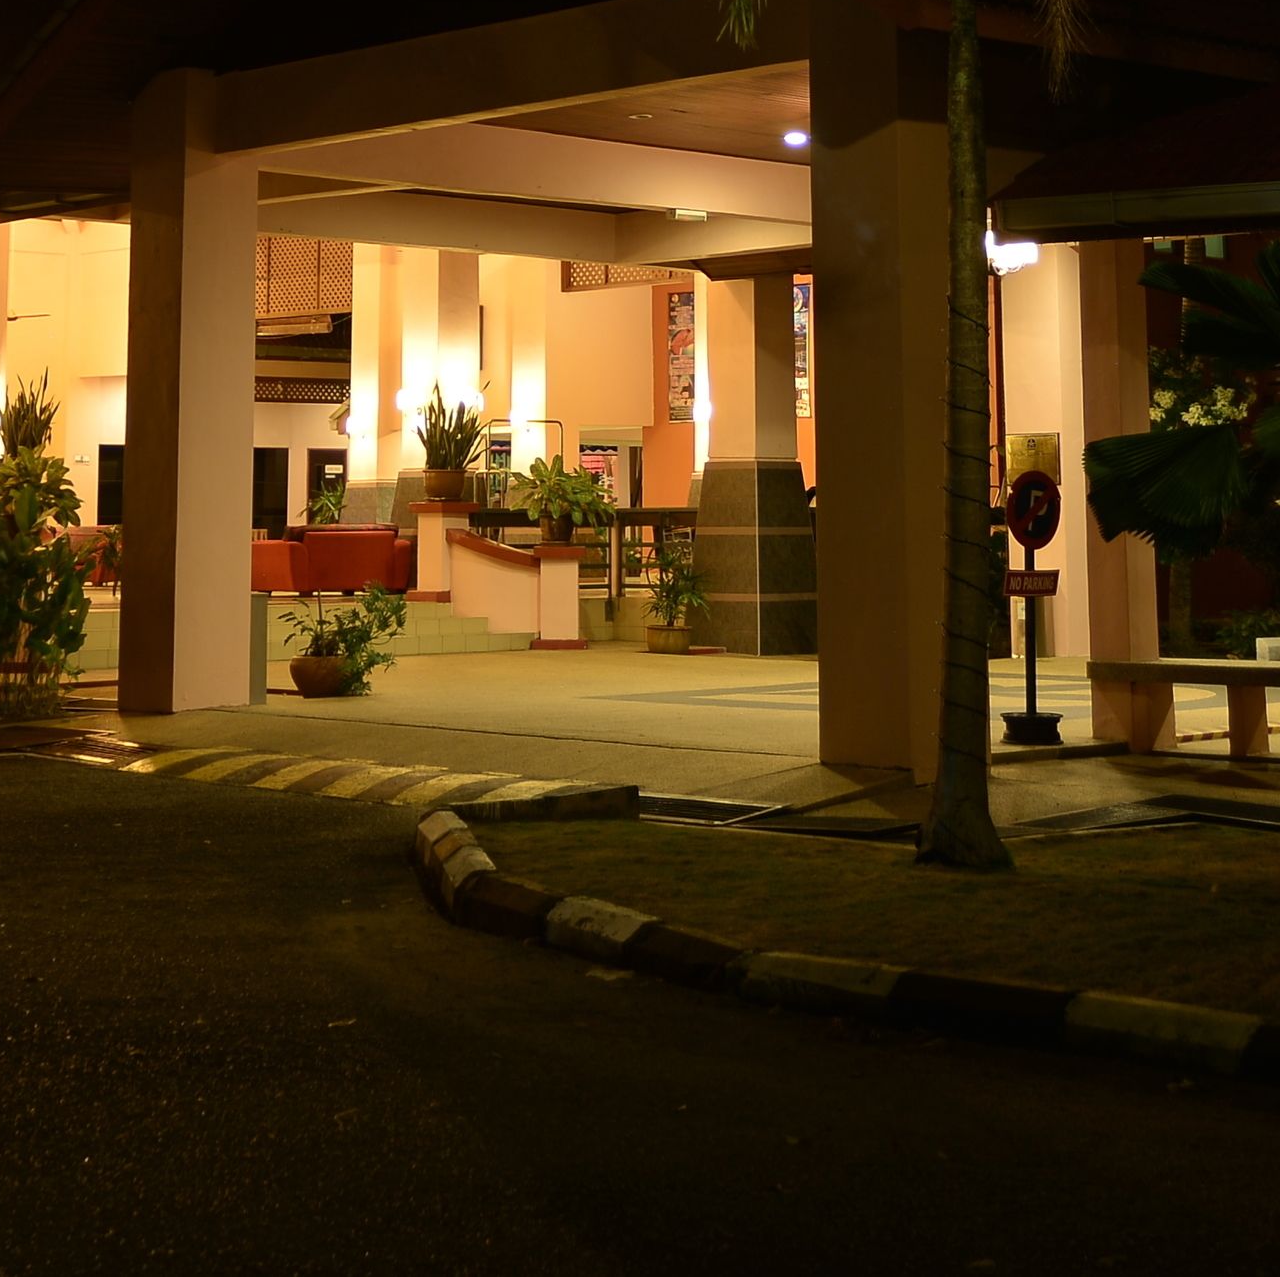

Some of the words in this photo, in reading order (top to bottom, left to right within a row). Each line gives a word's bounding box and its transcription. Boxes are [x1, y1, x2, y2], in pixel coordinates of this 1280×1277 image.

[1027, 489, 1048, 531] P
[1009, 576, 1022, 591] NO
[1023, 575, 1055, 592] PARKING
